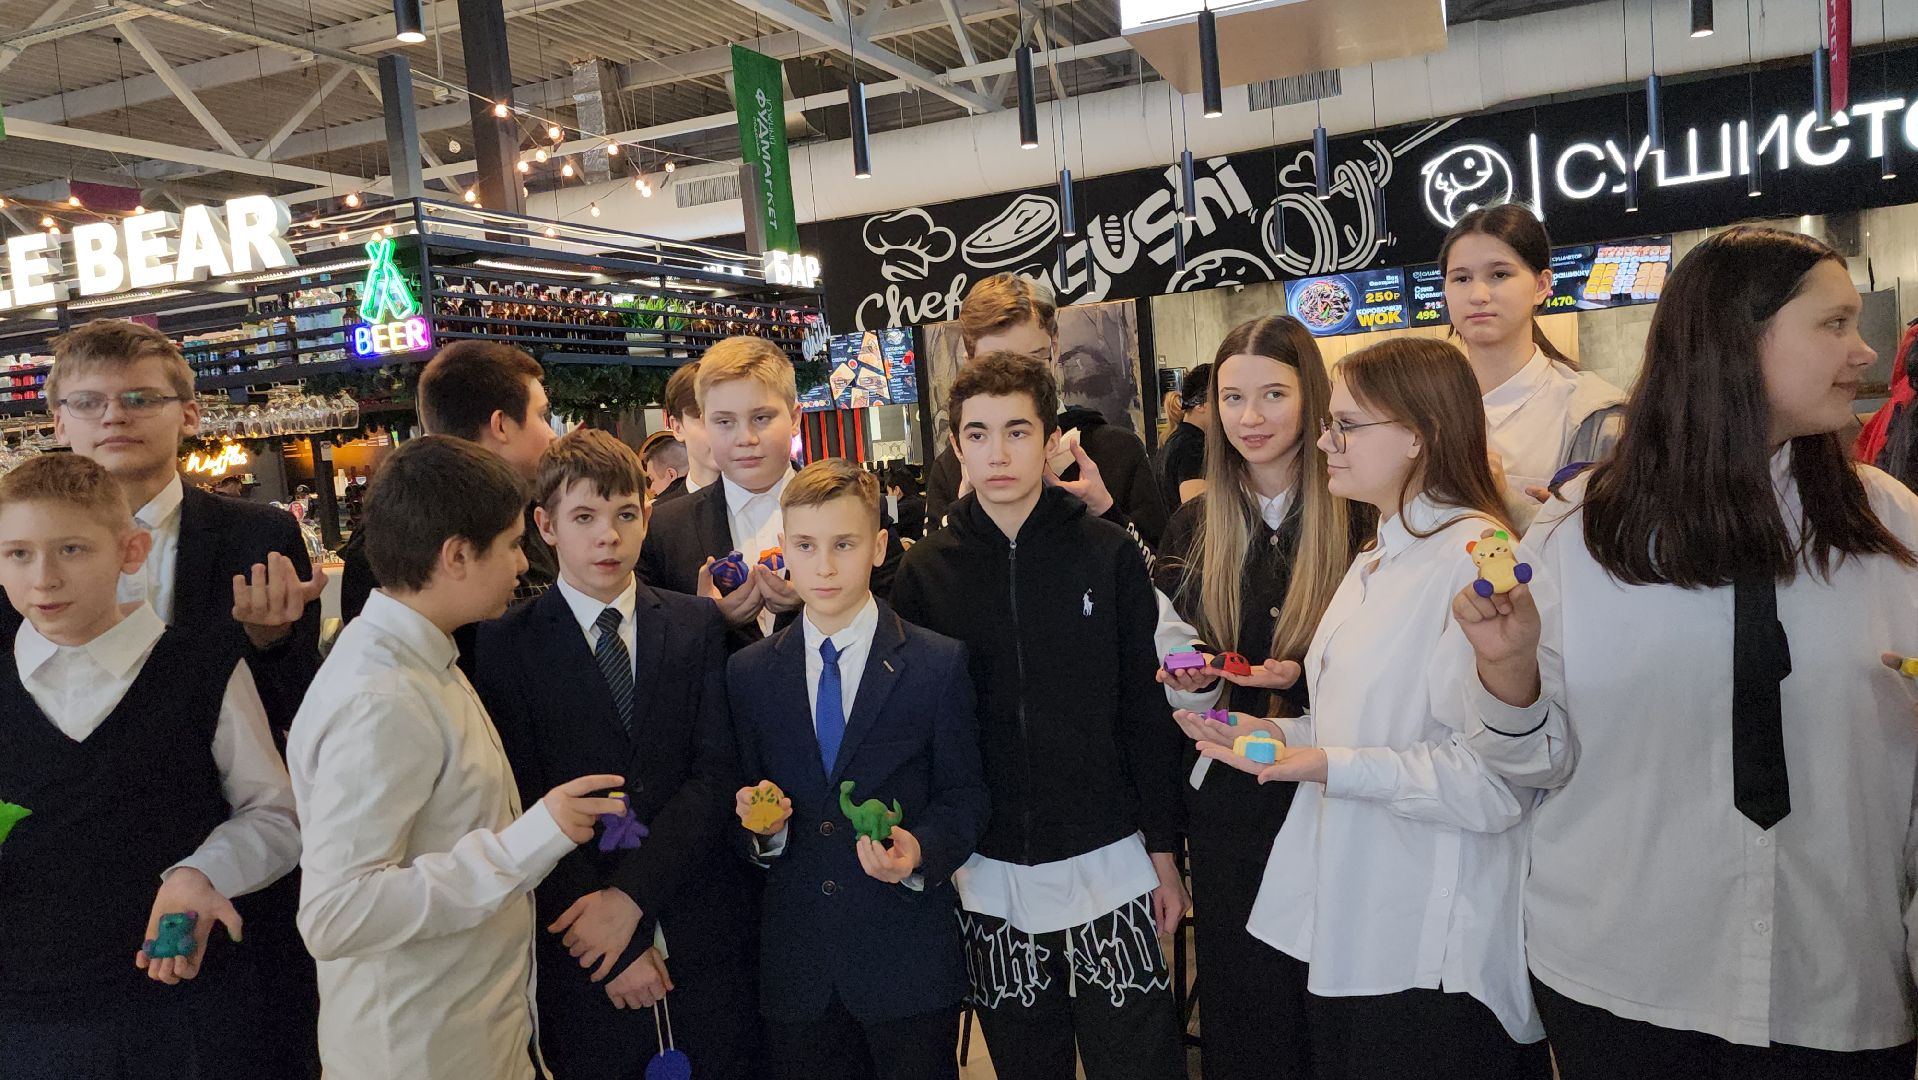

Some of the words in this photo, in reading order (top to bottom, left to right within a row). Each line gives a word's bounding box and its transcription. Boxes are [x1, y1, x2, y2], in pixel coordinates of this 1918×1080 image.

[1556, 95, 1918, 199] СУШИСТО
[72, 194, 290, 297] BEAR
[764, 249, 821, 289] БАР
[855, 272, 968, 331] Chef
[1357, 311, 1403, 327] WOK
[354, 316, 431, 357] BEER
